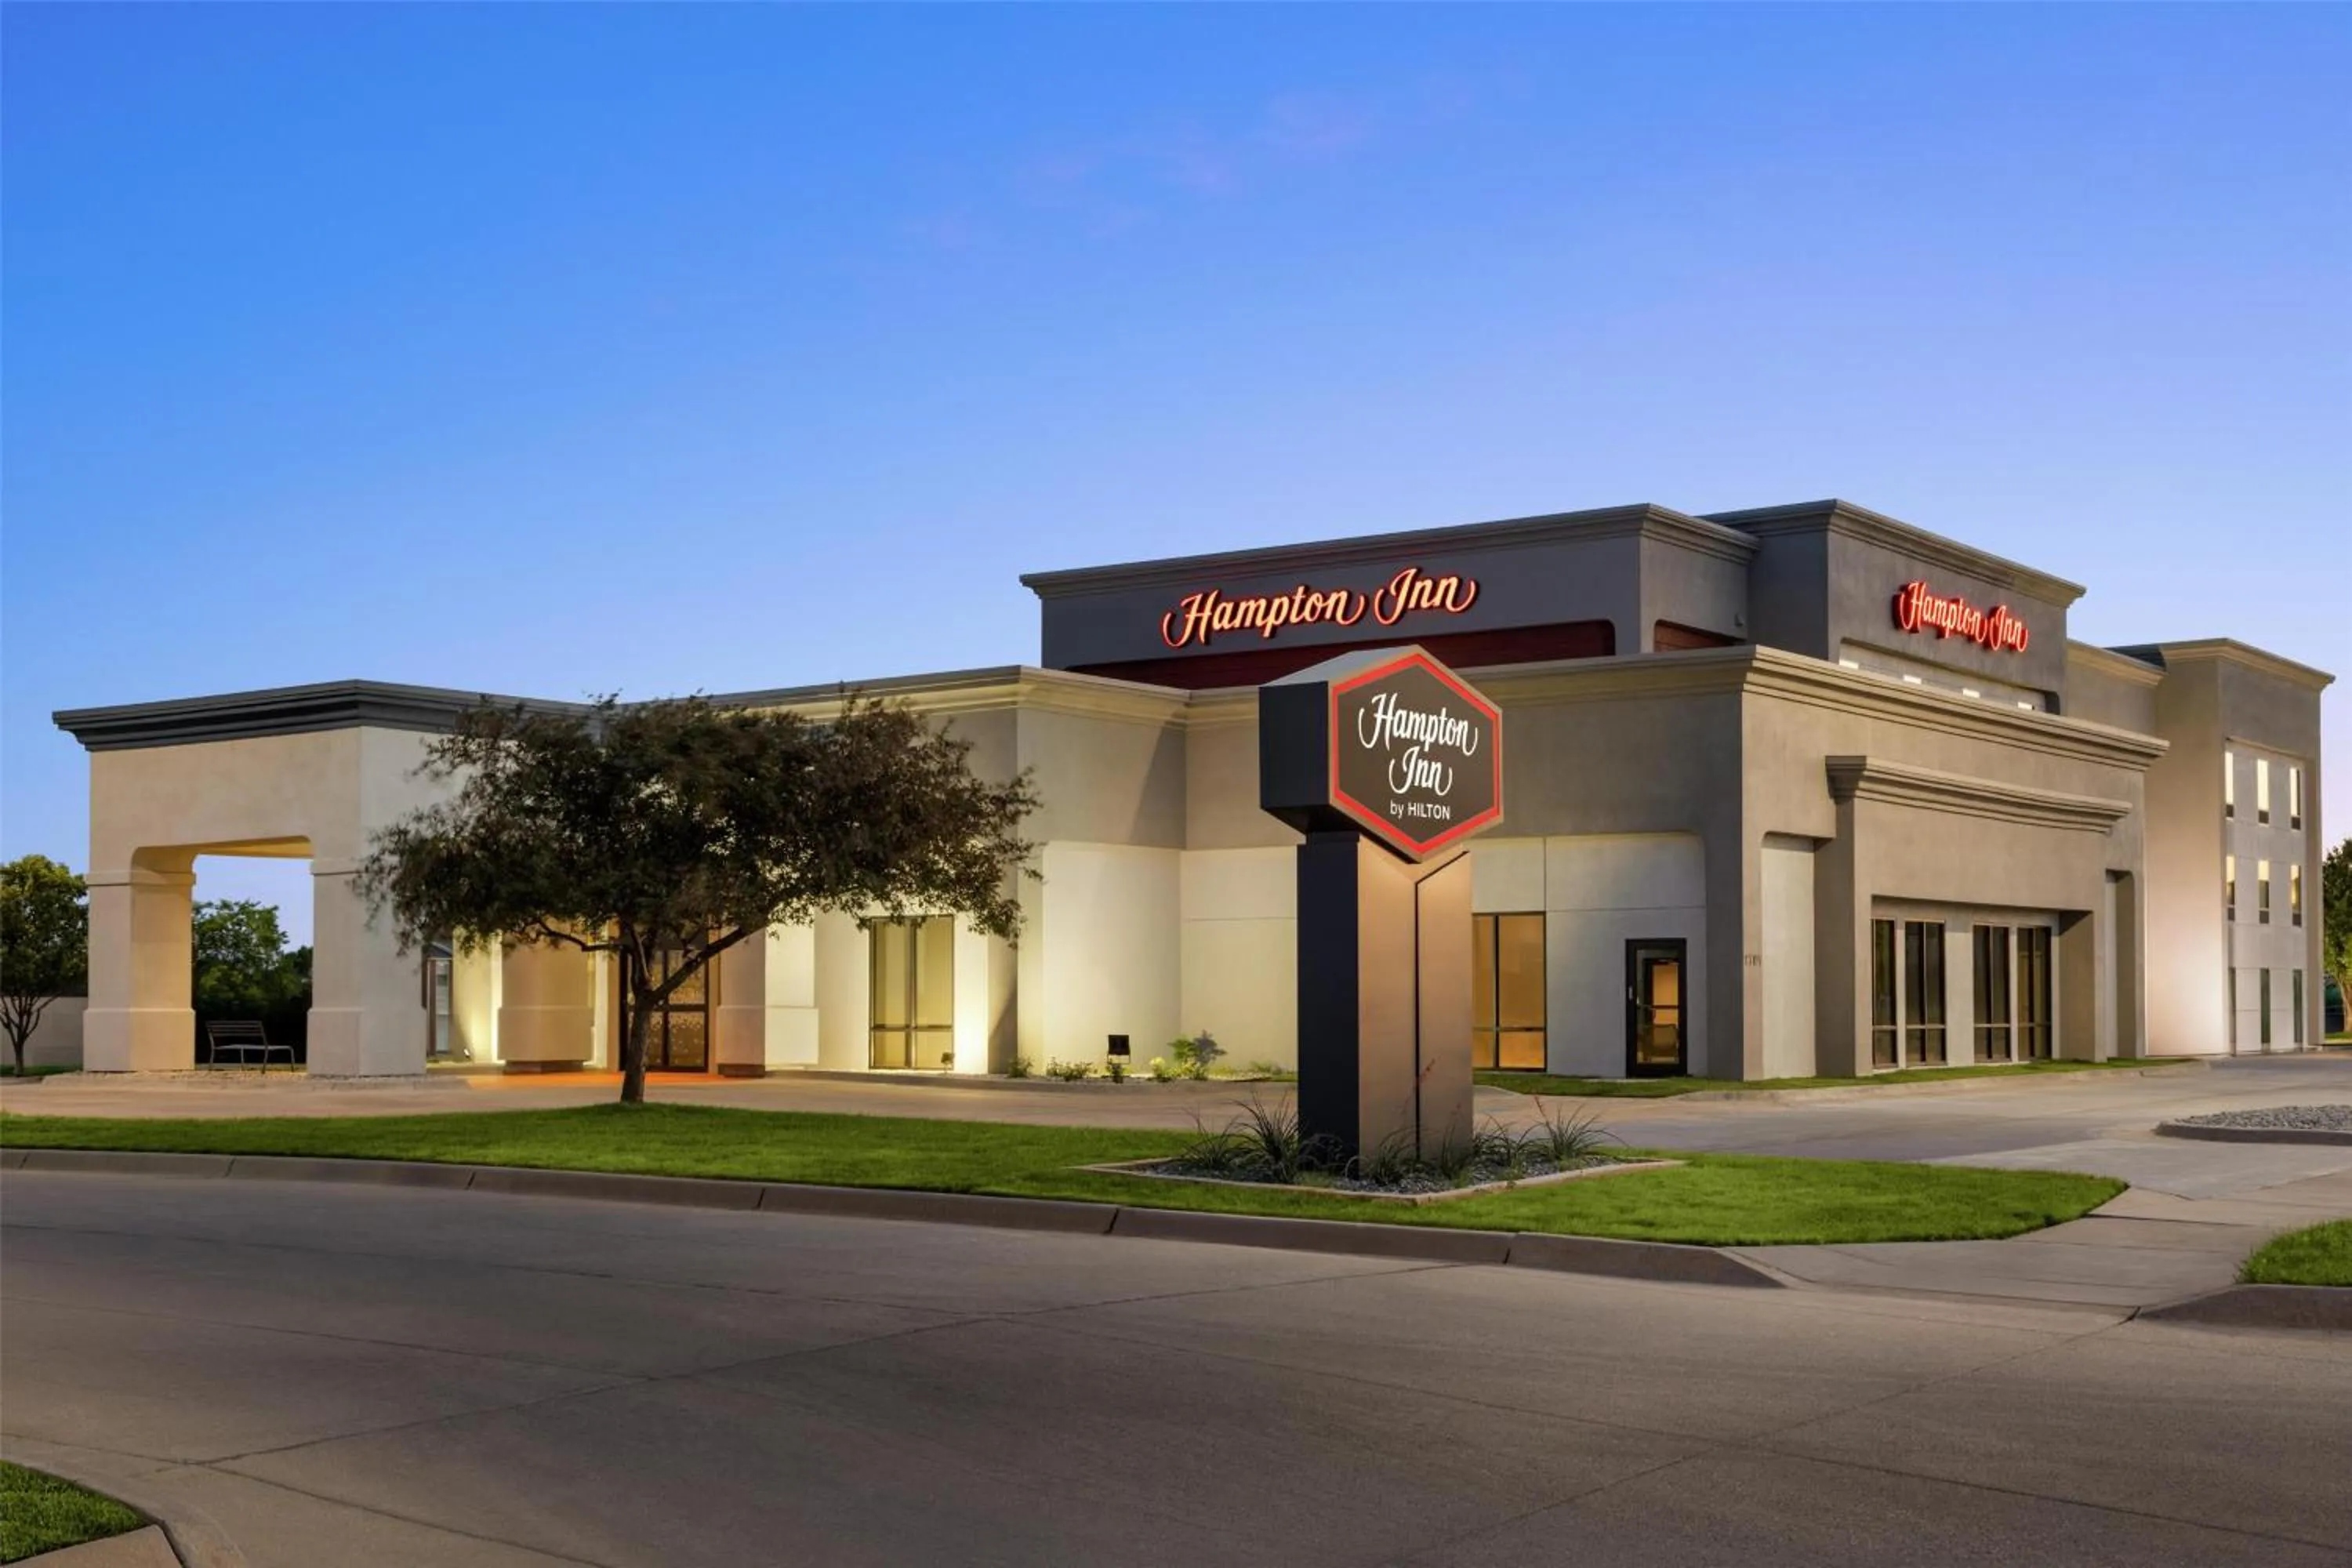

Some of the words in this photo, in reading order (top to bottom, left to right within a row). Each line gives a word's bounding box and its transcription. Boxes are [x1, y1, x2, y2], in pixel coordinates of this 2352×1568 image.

[1163, 586, 1366, 647] Hampton
[1374, 568, 1477, 626] Inn
[1897, 580, 1987, 643] Hampton
[1989, 604, 2029, 652] Inn
[1358, 692, 1478, 756] Hampton
[1388, 746, 1453, 796] Inn
[1390, 800, 1404, 818] by
[1407, 802, 1450, 819] HILTON
